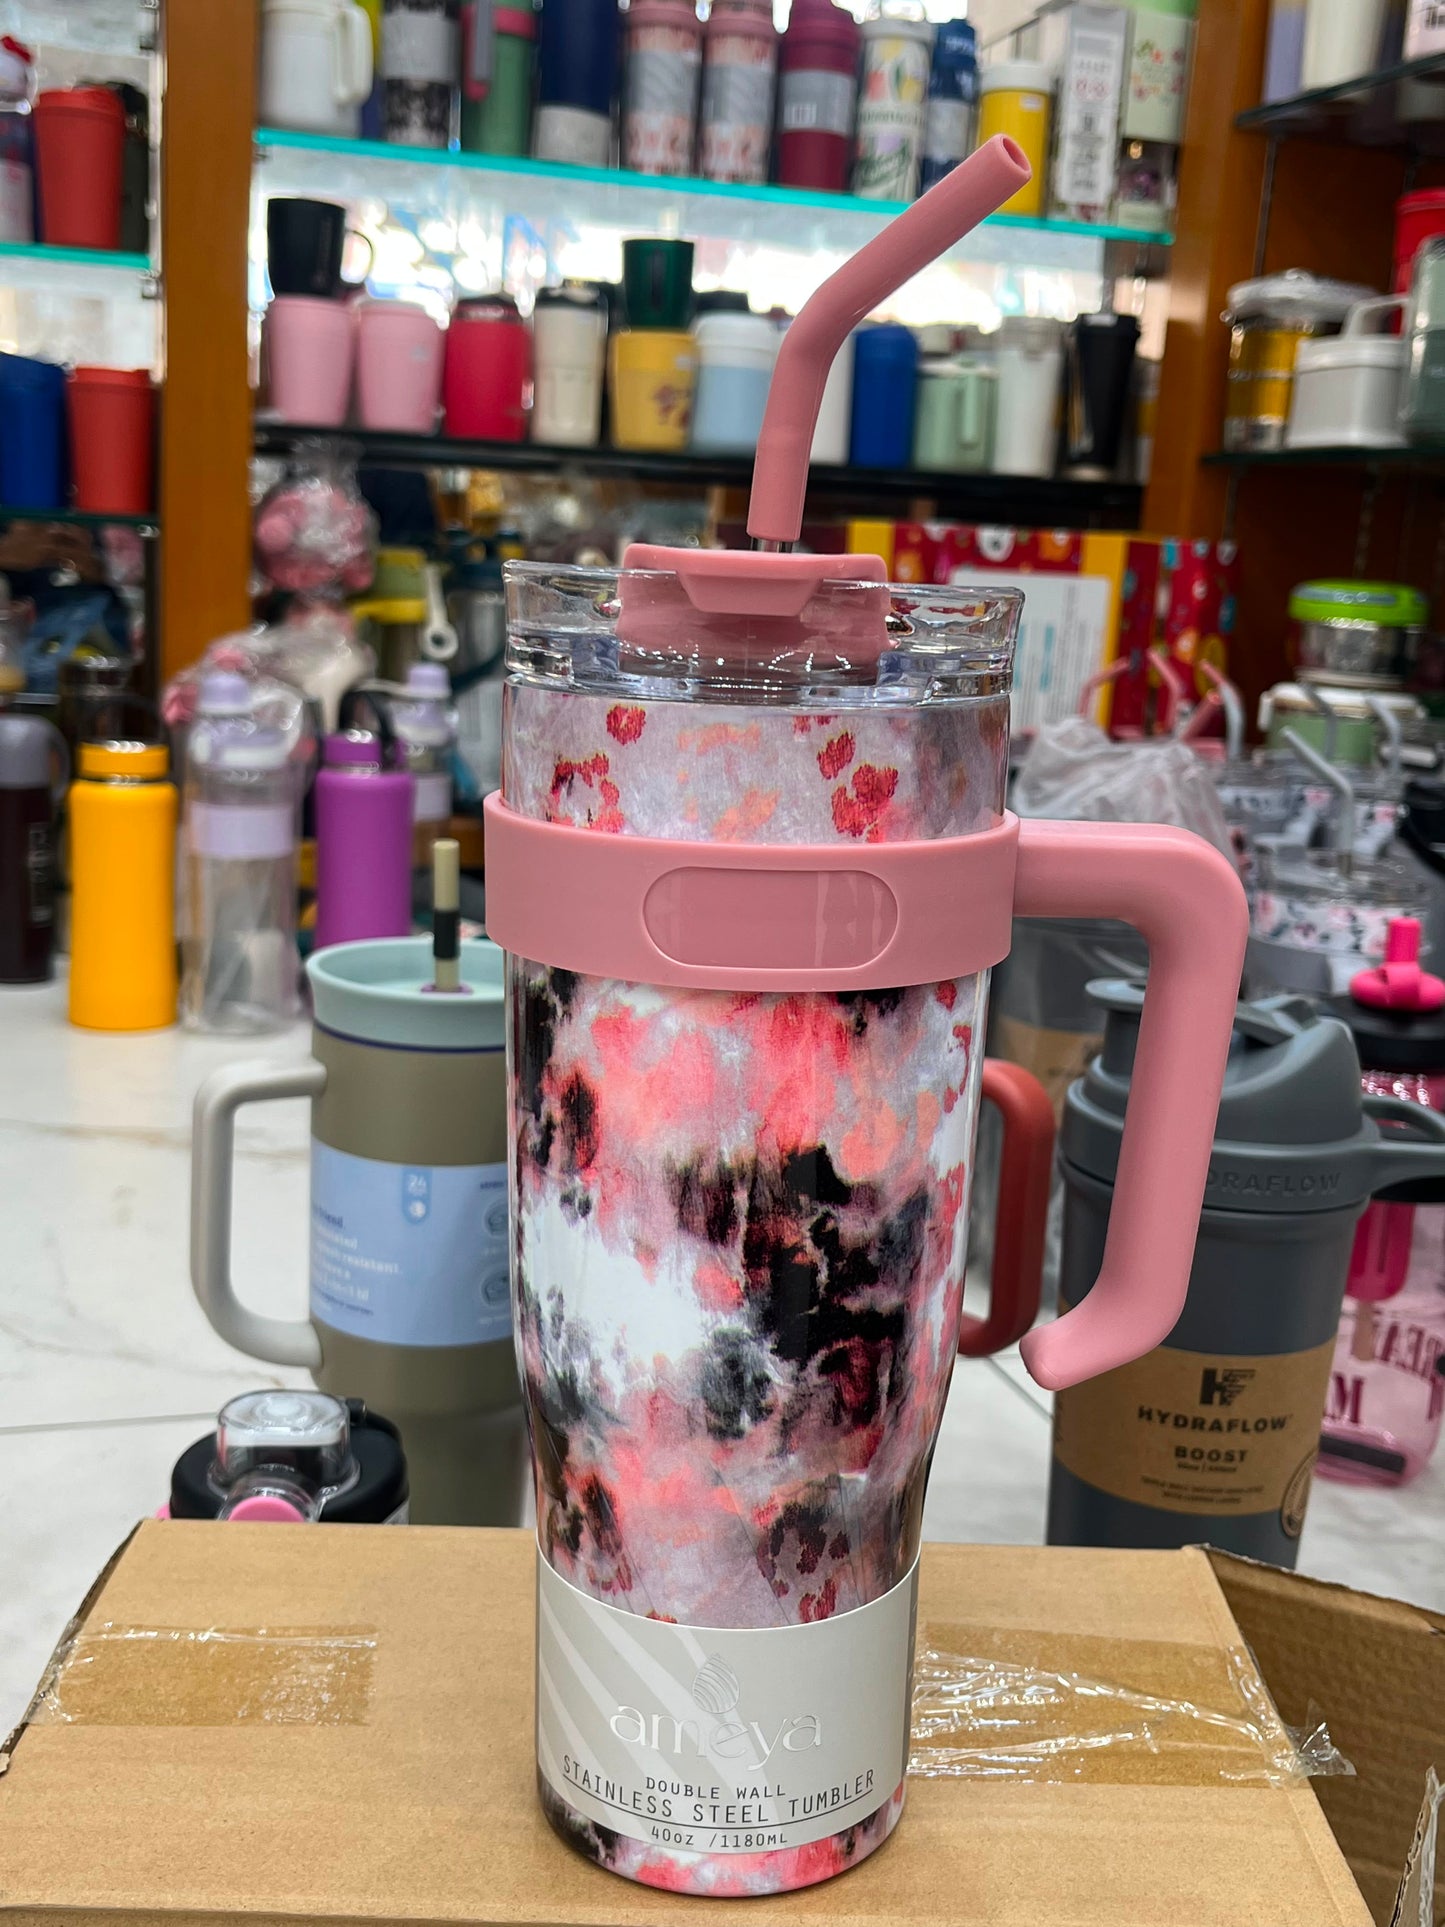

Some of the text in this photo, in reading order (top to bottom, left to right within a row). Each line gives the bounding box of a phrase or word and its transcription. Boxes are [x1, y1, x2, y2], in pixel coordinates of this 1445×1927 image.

[1206, 1168, 1341, 1192] DRAFLOW
[1137, 1405, 1287, 1433] HYDRAFLOW
[1174, 1445, 1248, 1463] BOOST
[609, 1704, 823, 1771] ameya
[563, 1754, 874, 1824] STAINLESS STEEL TUMBLER
[646, 1776, 786, 1800] DOUBLE WALL
